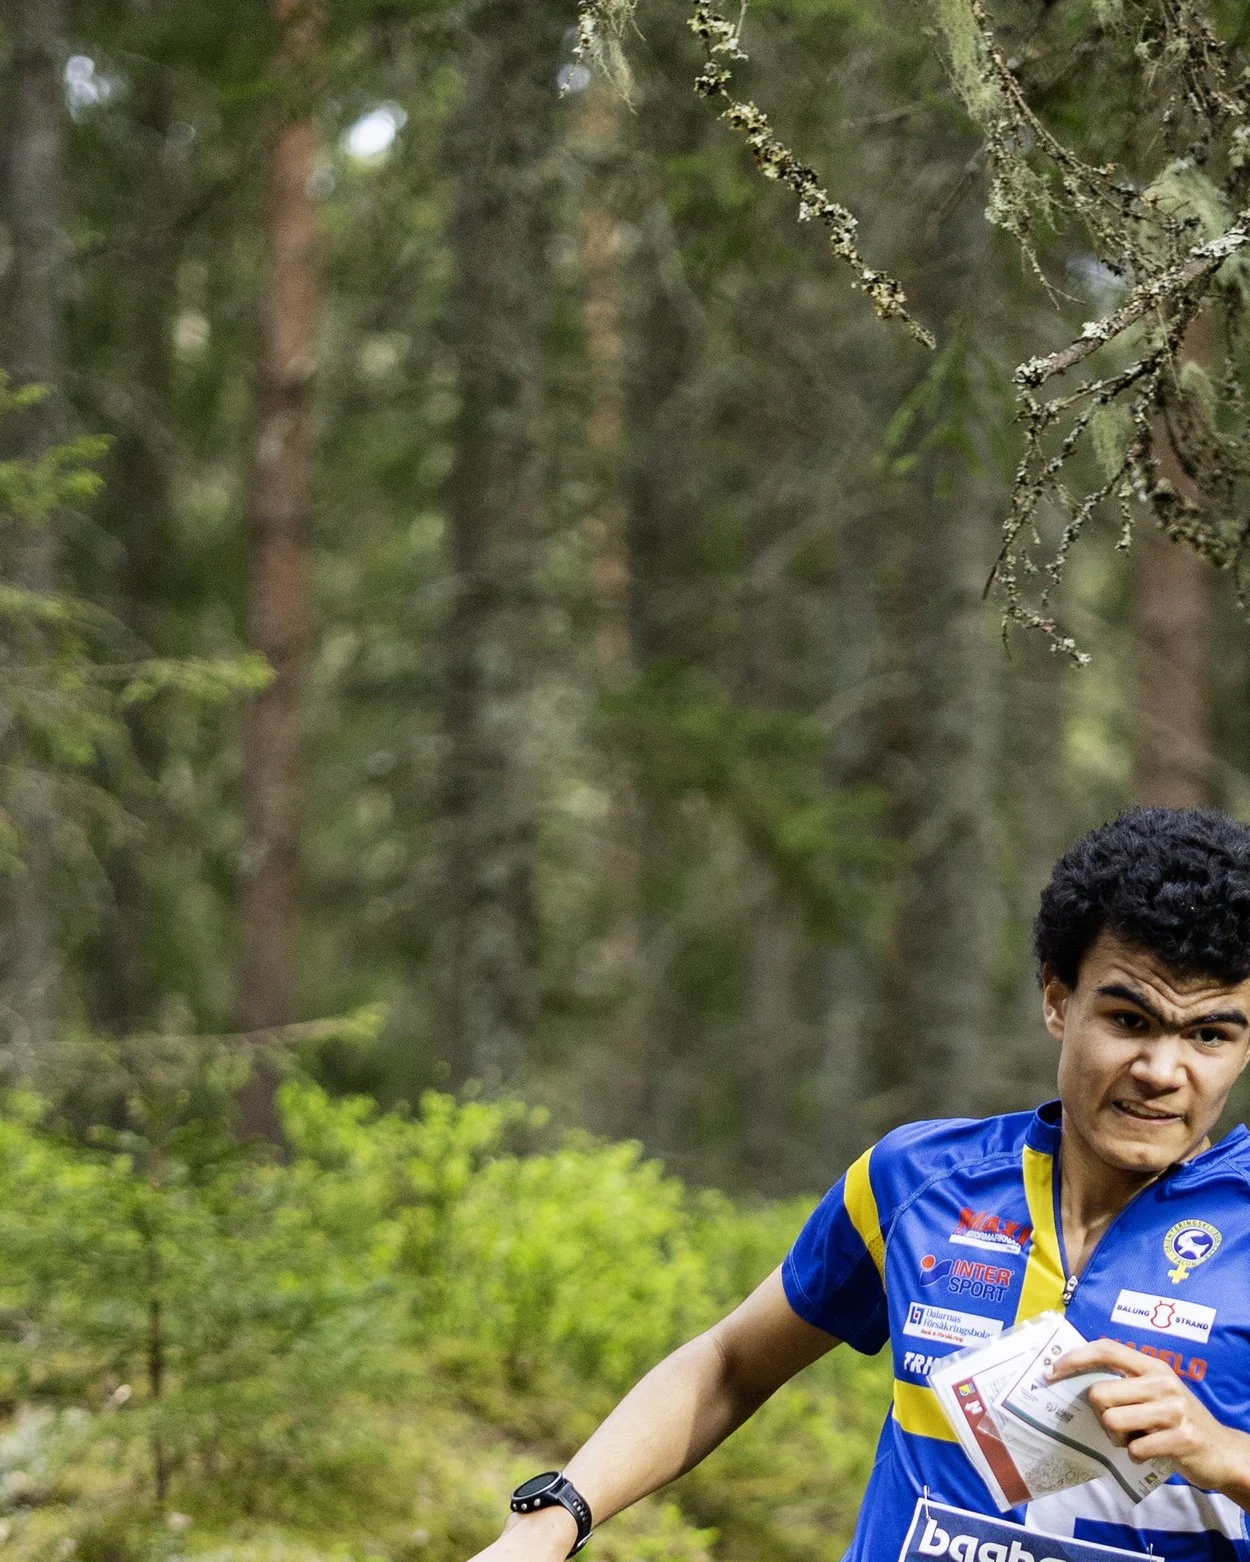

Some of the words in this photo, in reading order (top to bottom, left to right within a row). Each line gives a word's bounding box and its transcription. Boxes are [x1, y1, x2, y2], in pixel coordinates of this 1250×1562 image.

[958, 1207, 1030, 1246] MAXI
[953, 1259, 1011, 1287] INTER
[949, 1277, 1007, 1302] SPORT
[926, 1308, 962, 1323] Dalarnas
[1116, 1304, 1150, 1317] BALUNG
[1175, 1316, 1209, 1330] STRAND
